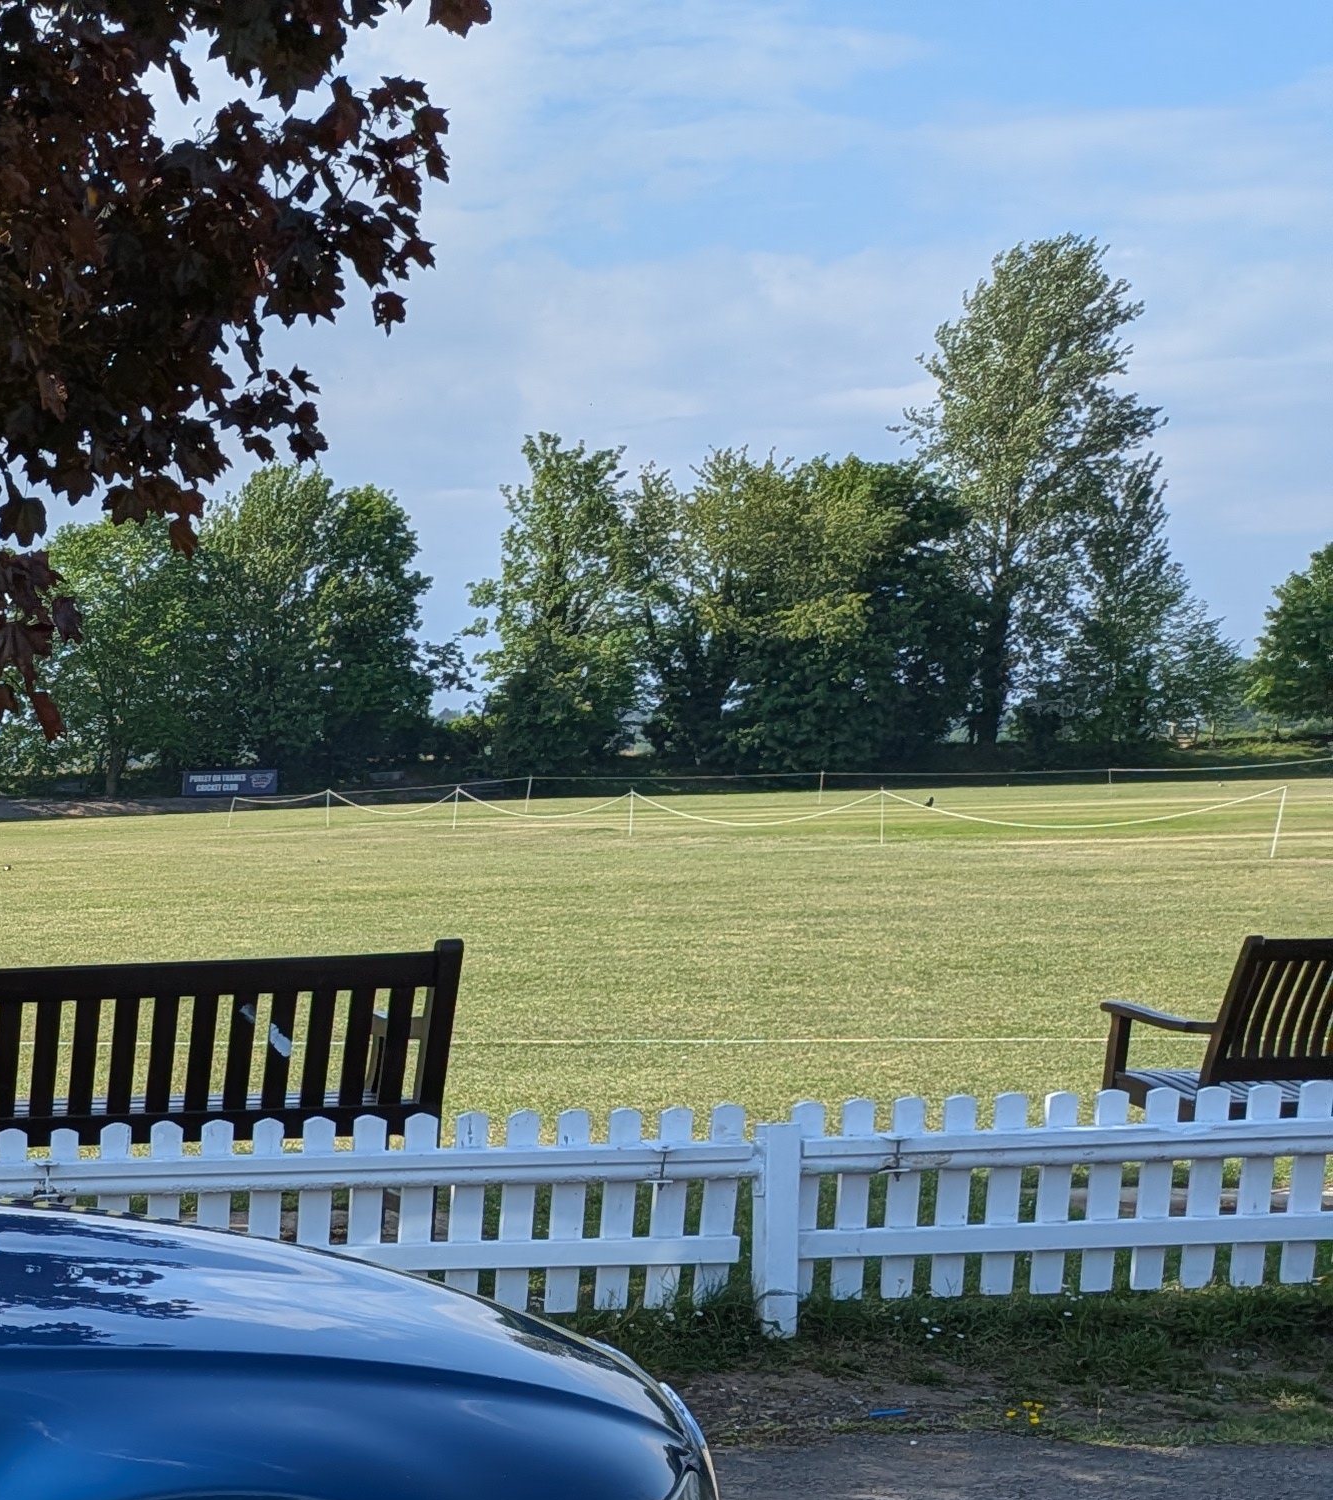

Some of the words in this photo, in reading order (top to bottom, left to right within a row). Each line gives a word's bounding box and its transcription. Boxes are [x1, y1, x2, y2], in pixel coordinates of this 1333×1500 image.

[212, 774, 221, 782] ON
[222, 774, 247, 782] THAMES
[196, 784, 222, 792] CRICKET
[222, 783, 239, 791] CLUB
